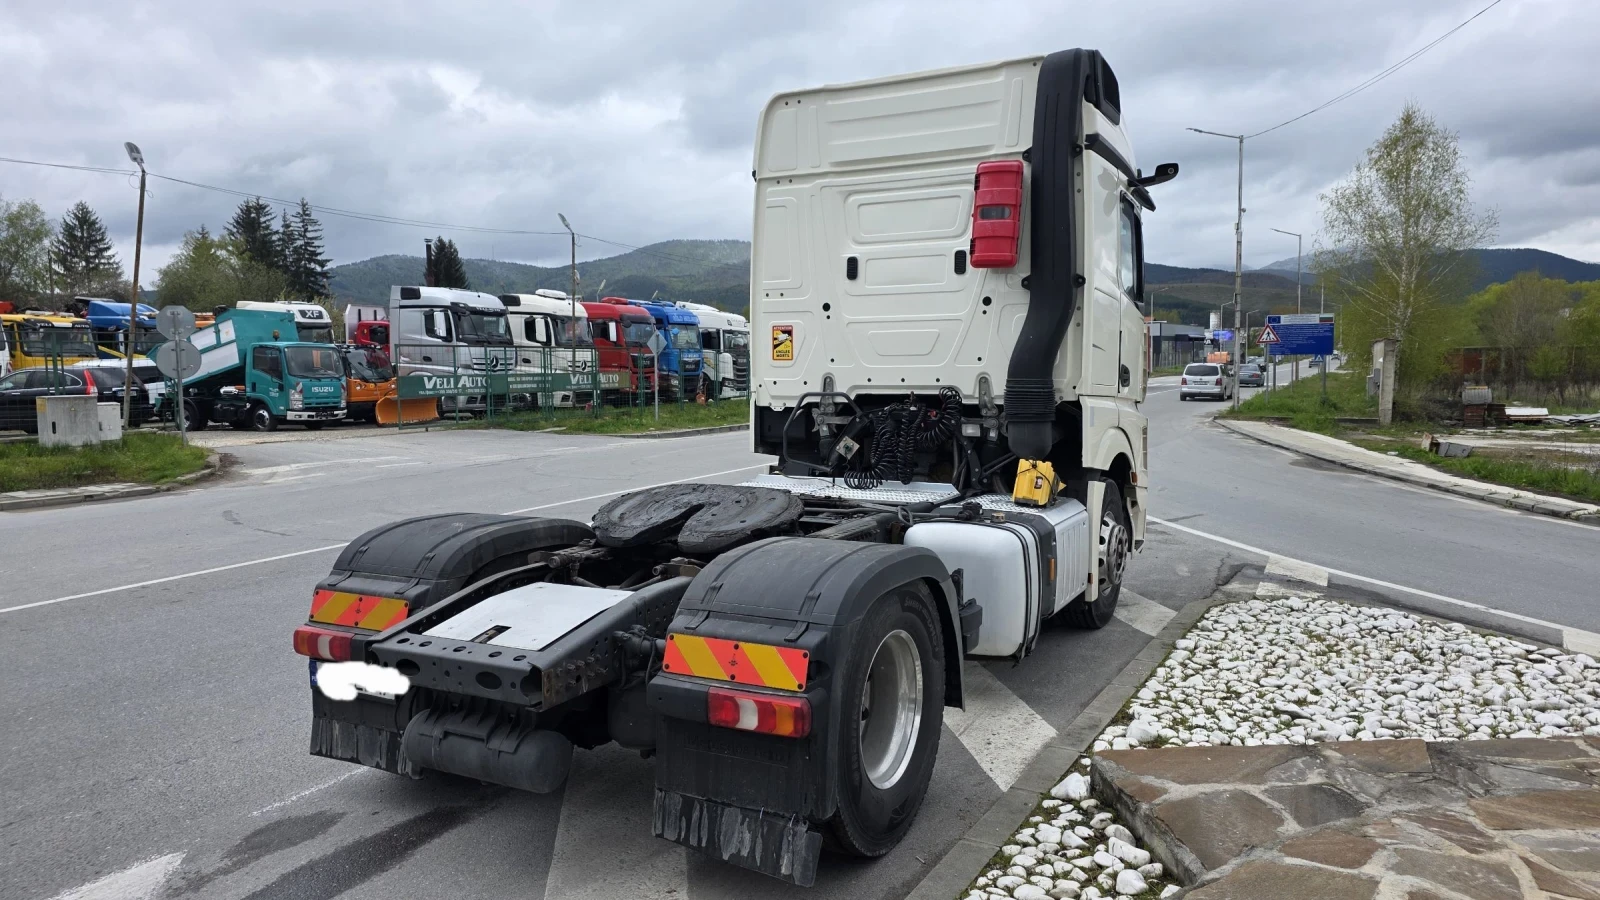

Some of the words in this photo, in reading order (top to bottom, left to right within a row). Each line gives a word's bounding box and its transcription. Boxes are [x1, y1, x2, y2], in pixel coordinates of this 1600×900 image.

[306, 310, 320, 318] XF
[423, 376, 455, 389] VELI
[569, 374, 592, 385] VELI
[598, 373, 619, 383] AUTO
